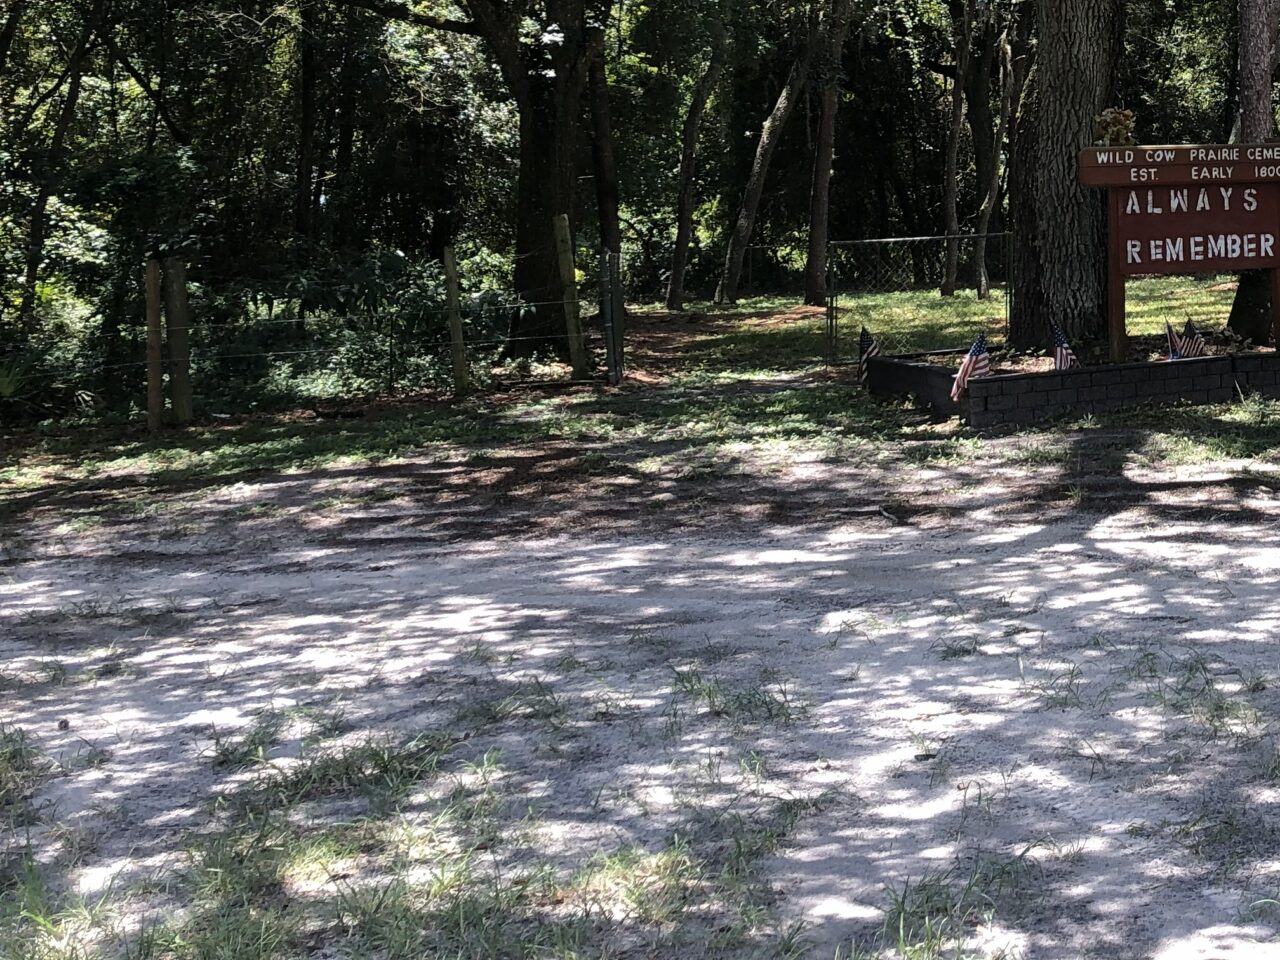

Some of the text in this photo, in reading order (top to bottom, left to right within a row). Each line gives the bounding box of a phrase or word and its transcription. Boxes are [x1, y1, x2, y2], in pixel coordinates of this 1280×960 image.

[1096, 150, 1134, 164] WILD
[1145, 150, 1176, 162] COW
[1190, 148, 1240, 162] PRAIRIE
[1191, 166, 1234, 180] EARLY
[1126, 187, 1258, 214] ALWAYS
[1126, 233, 1275, 264] REMEMBER
